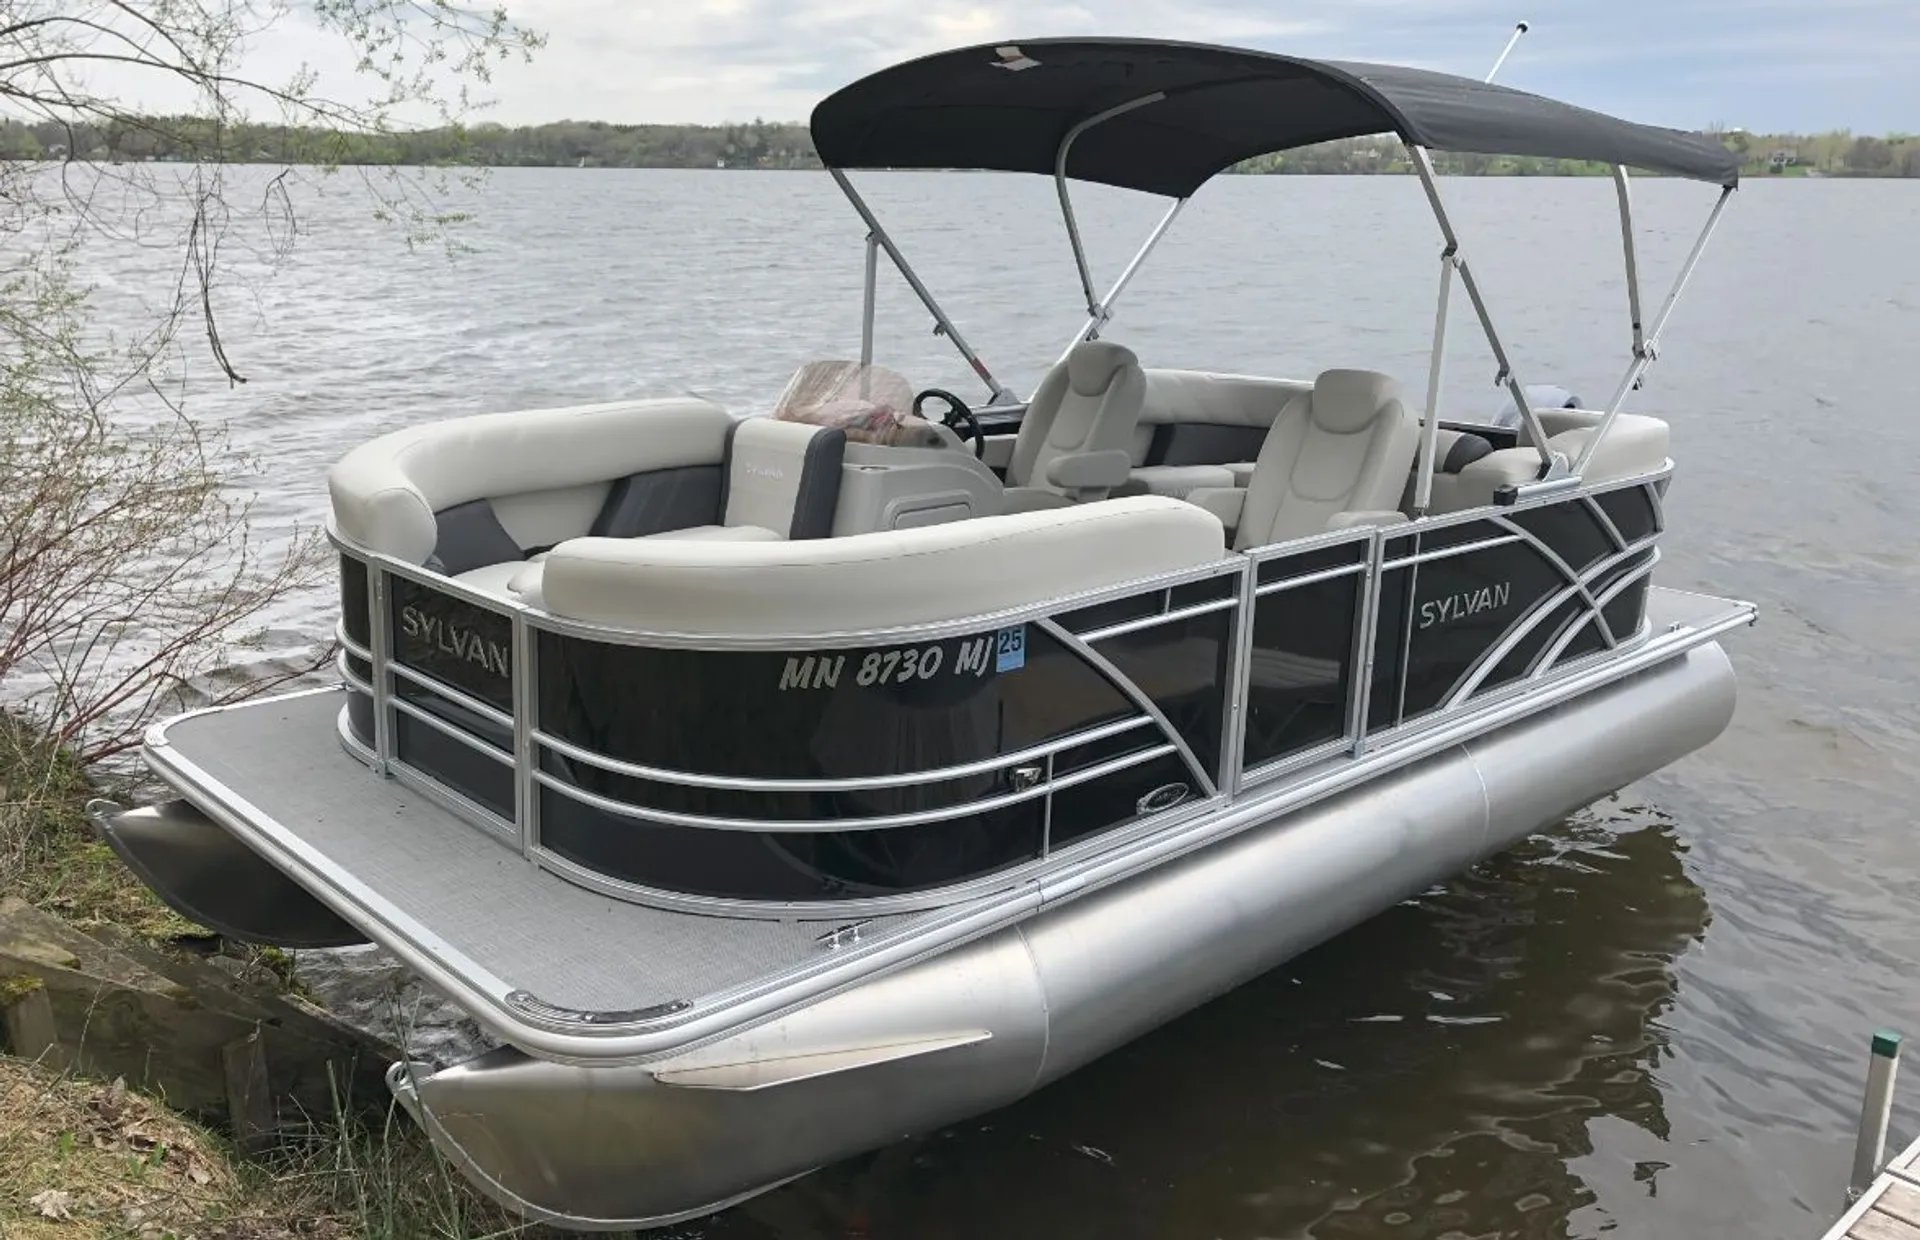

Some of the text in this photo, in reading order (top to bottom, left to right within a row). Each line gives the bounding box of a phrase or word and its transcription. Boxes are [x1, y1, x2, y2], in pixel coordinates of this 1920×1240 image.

[1420, 582, 1510, 629] SYLVAN
[402, 606, 509, 678] SYLVAN
[779, 636, 994, 691] MN 8730 MJ
[999, 630, 1022, 654] 25
